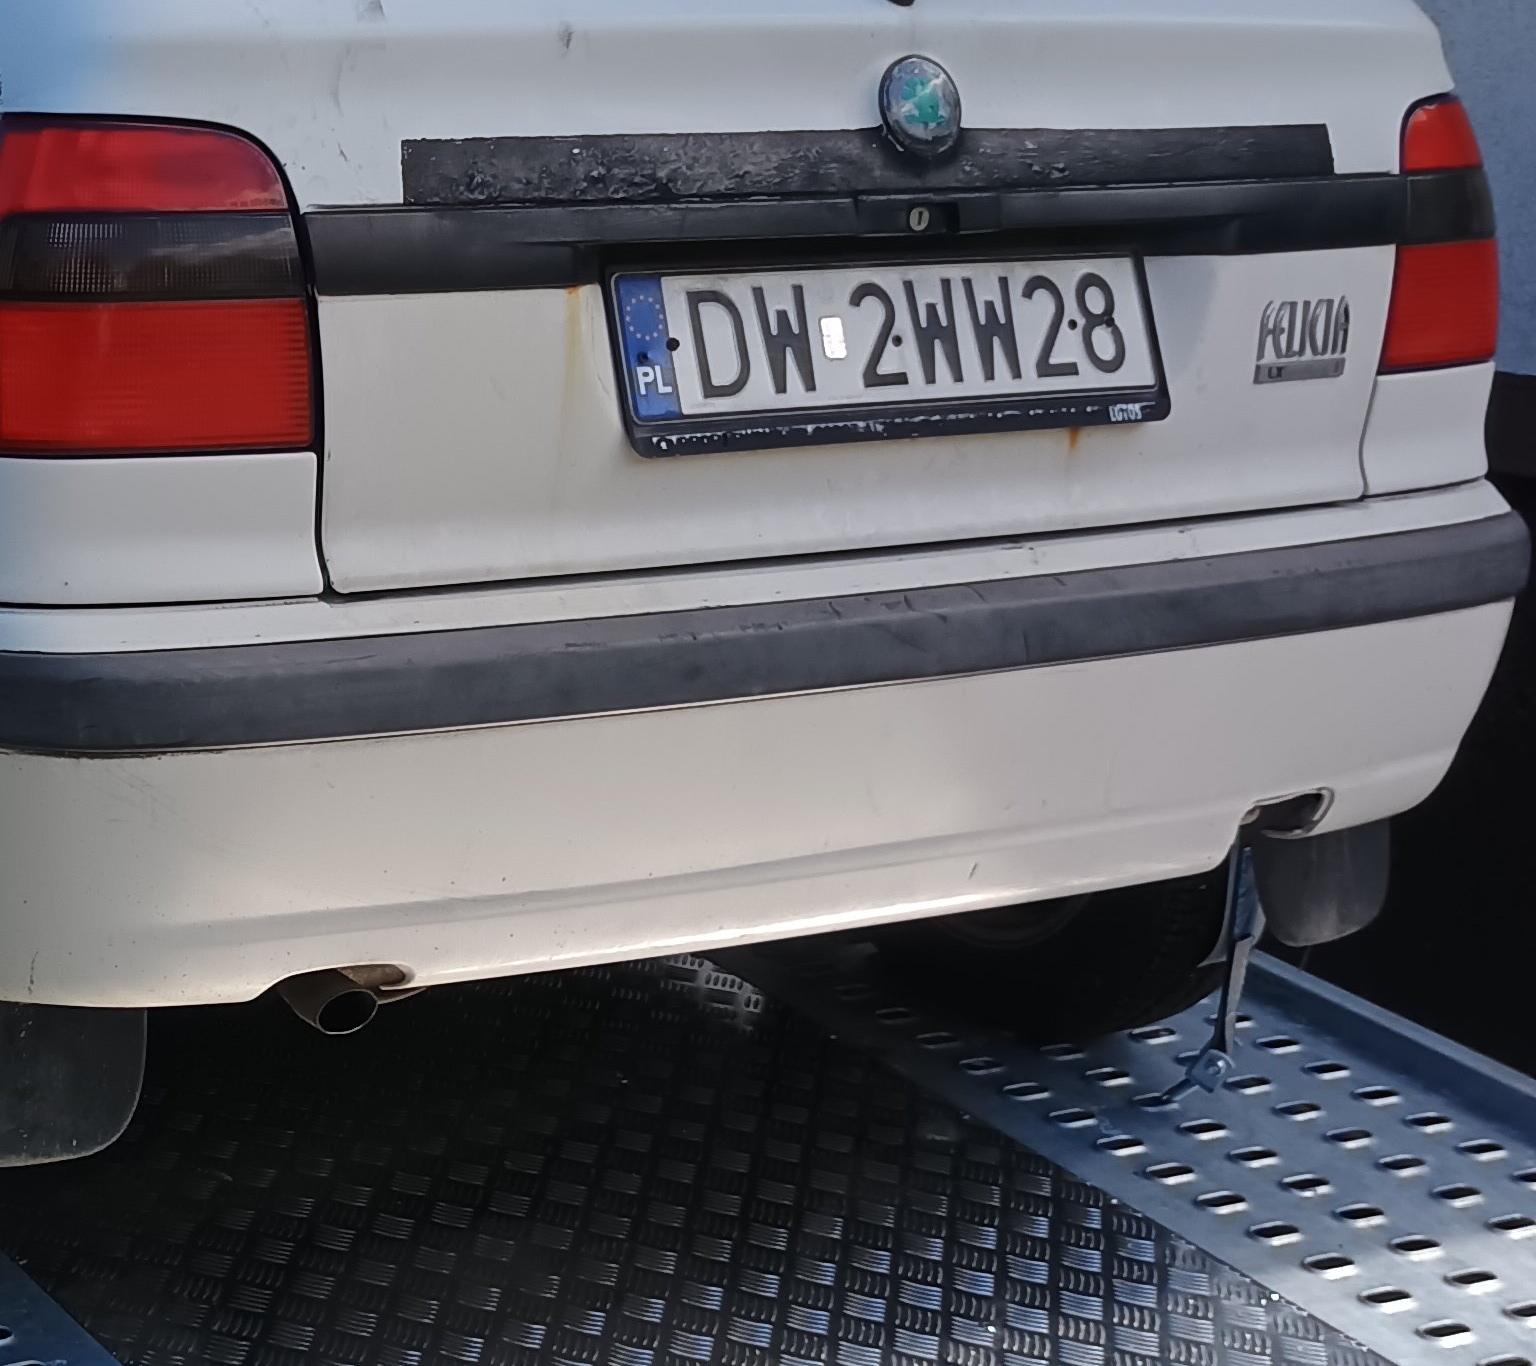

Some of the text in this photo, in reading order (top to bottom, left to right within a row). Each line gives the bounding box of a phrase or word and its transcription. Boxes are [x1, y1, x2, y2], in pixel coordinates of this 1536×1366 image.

[685, 271, 1127, 399] DW 2WW28
[636, 365, 673, 395] PL
